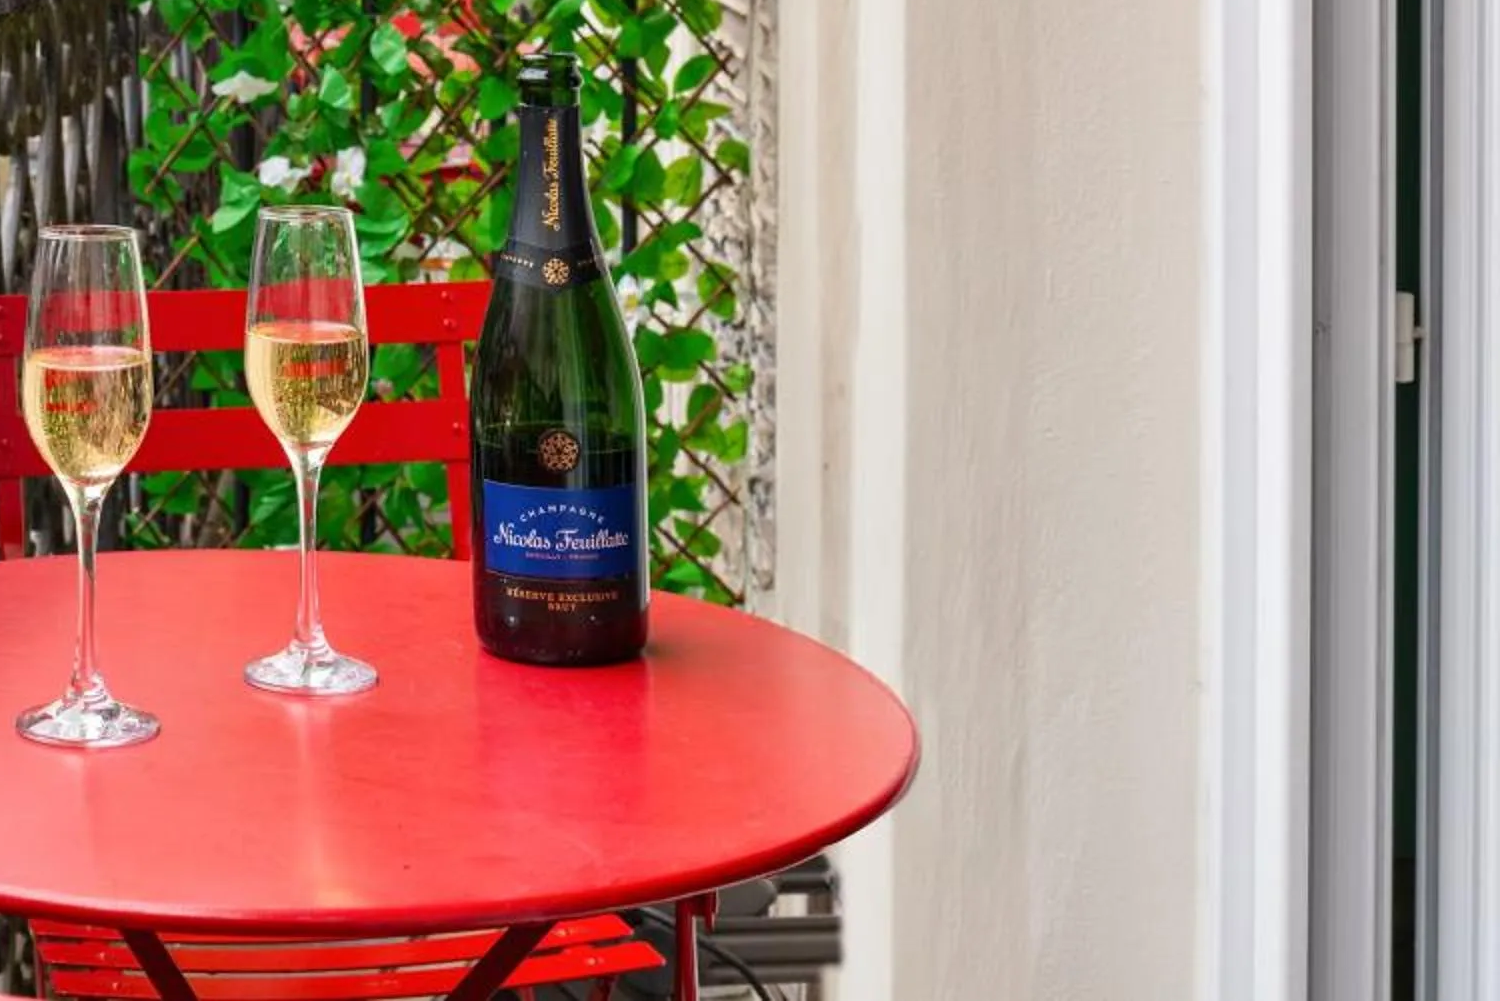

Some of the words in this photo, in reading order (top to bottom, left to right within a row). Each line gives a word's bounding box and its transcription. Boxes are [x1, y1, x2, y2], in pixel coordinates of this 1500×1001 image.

[519, 504, 604, 523] CHAMPAGNE
[493, 521, 551, 550] Nicolas
[555, 528, 629, 551] Feuillatte
[559, 592, 618, 603] EXCLUSIVE
[548, 603, 576, 612] BRUT
